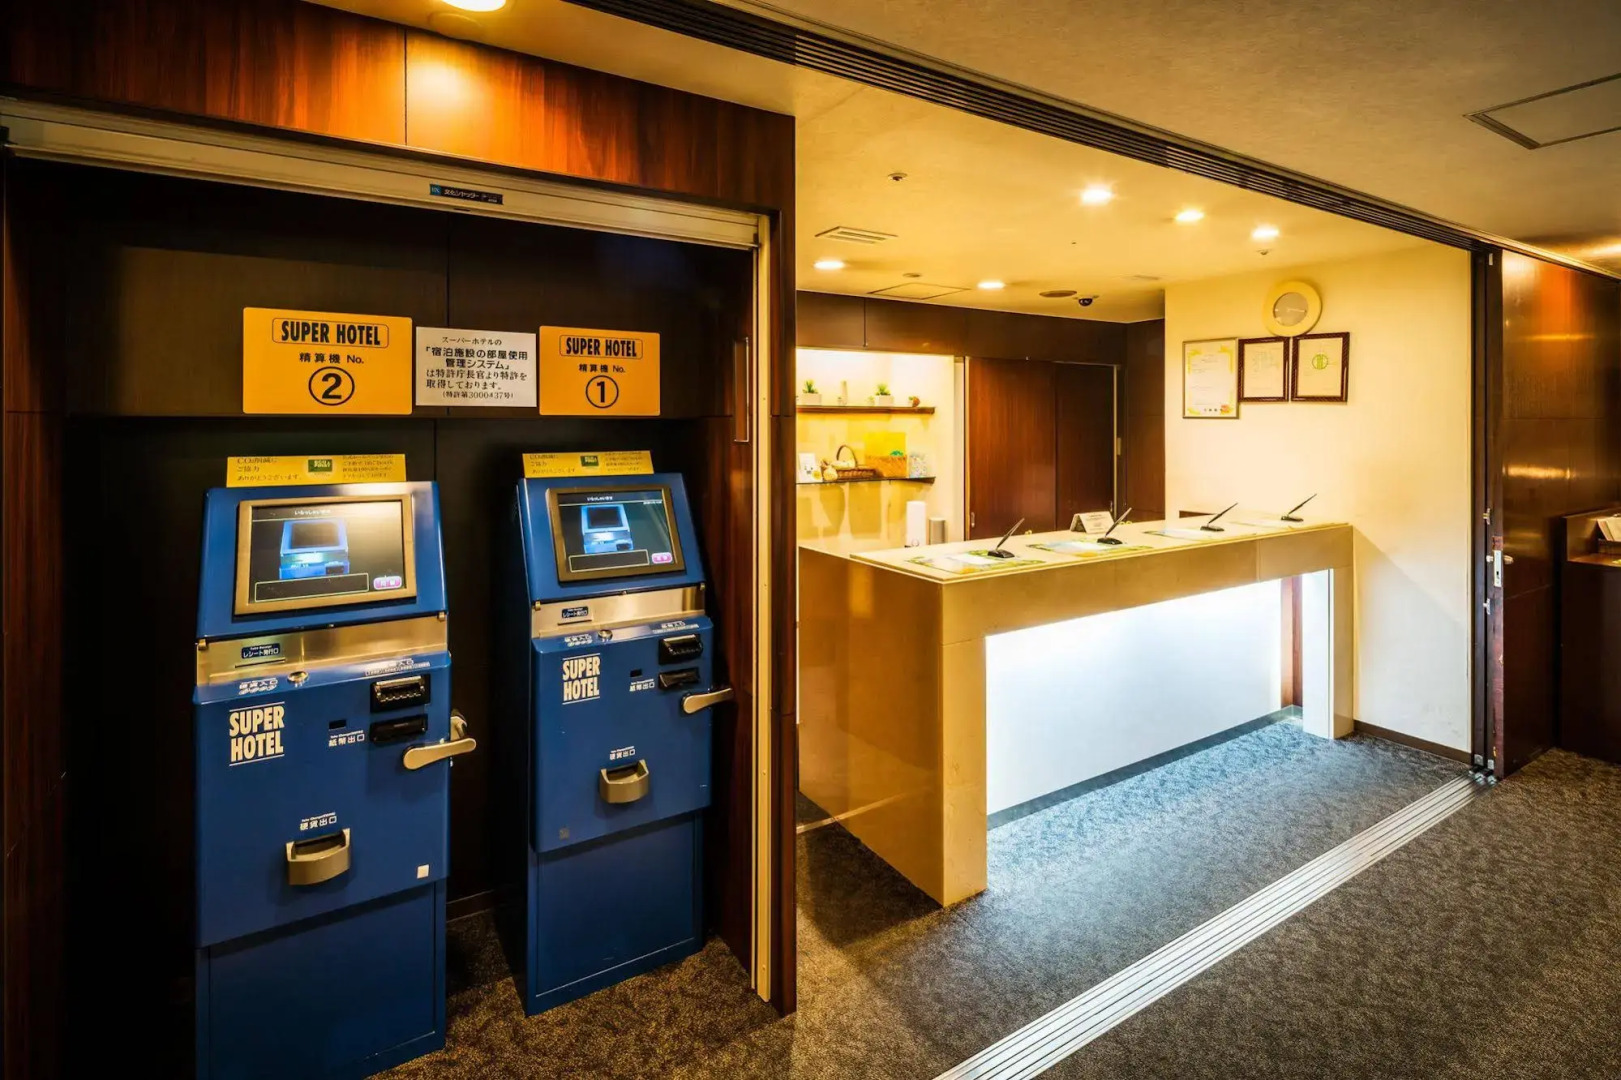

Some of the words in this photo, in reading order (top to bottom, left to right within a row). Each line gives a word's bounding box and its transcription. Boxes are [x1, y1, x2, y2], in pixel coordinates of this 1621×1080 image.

[281, 320, 330, 343] SUPER
[336, 323, 381, 346] HOTEL
[441, 336, 502, 346] スーパーホテルの
[566, 337, 601, 356] SUPER
[605, 338, 637, 357] HOTEL
[299, 352, 341, 364] 精算機
[346, 354, 364, 365] No.
[578, 364, 609, 373] 精算機
[612, 365, 626, 373] No.
[426, 369, 528, 381] は特許庁長官より特許を
[426, 379, 502, 391] 取得しております。
[562, 656, 601, 681] SUPER
[563, 676, 600, 702] HOTEL
[229, 705, 285, 737] SUPER
[230, 732, 285, 763] HOTEL
